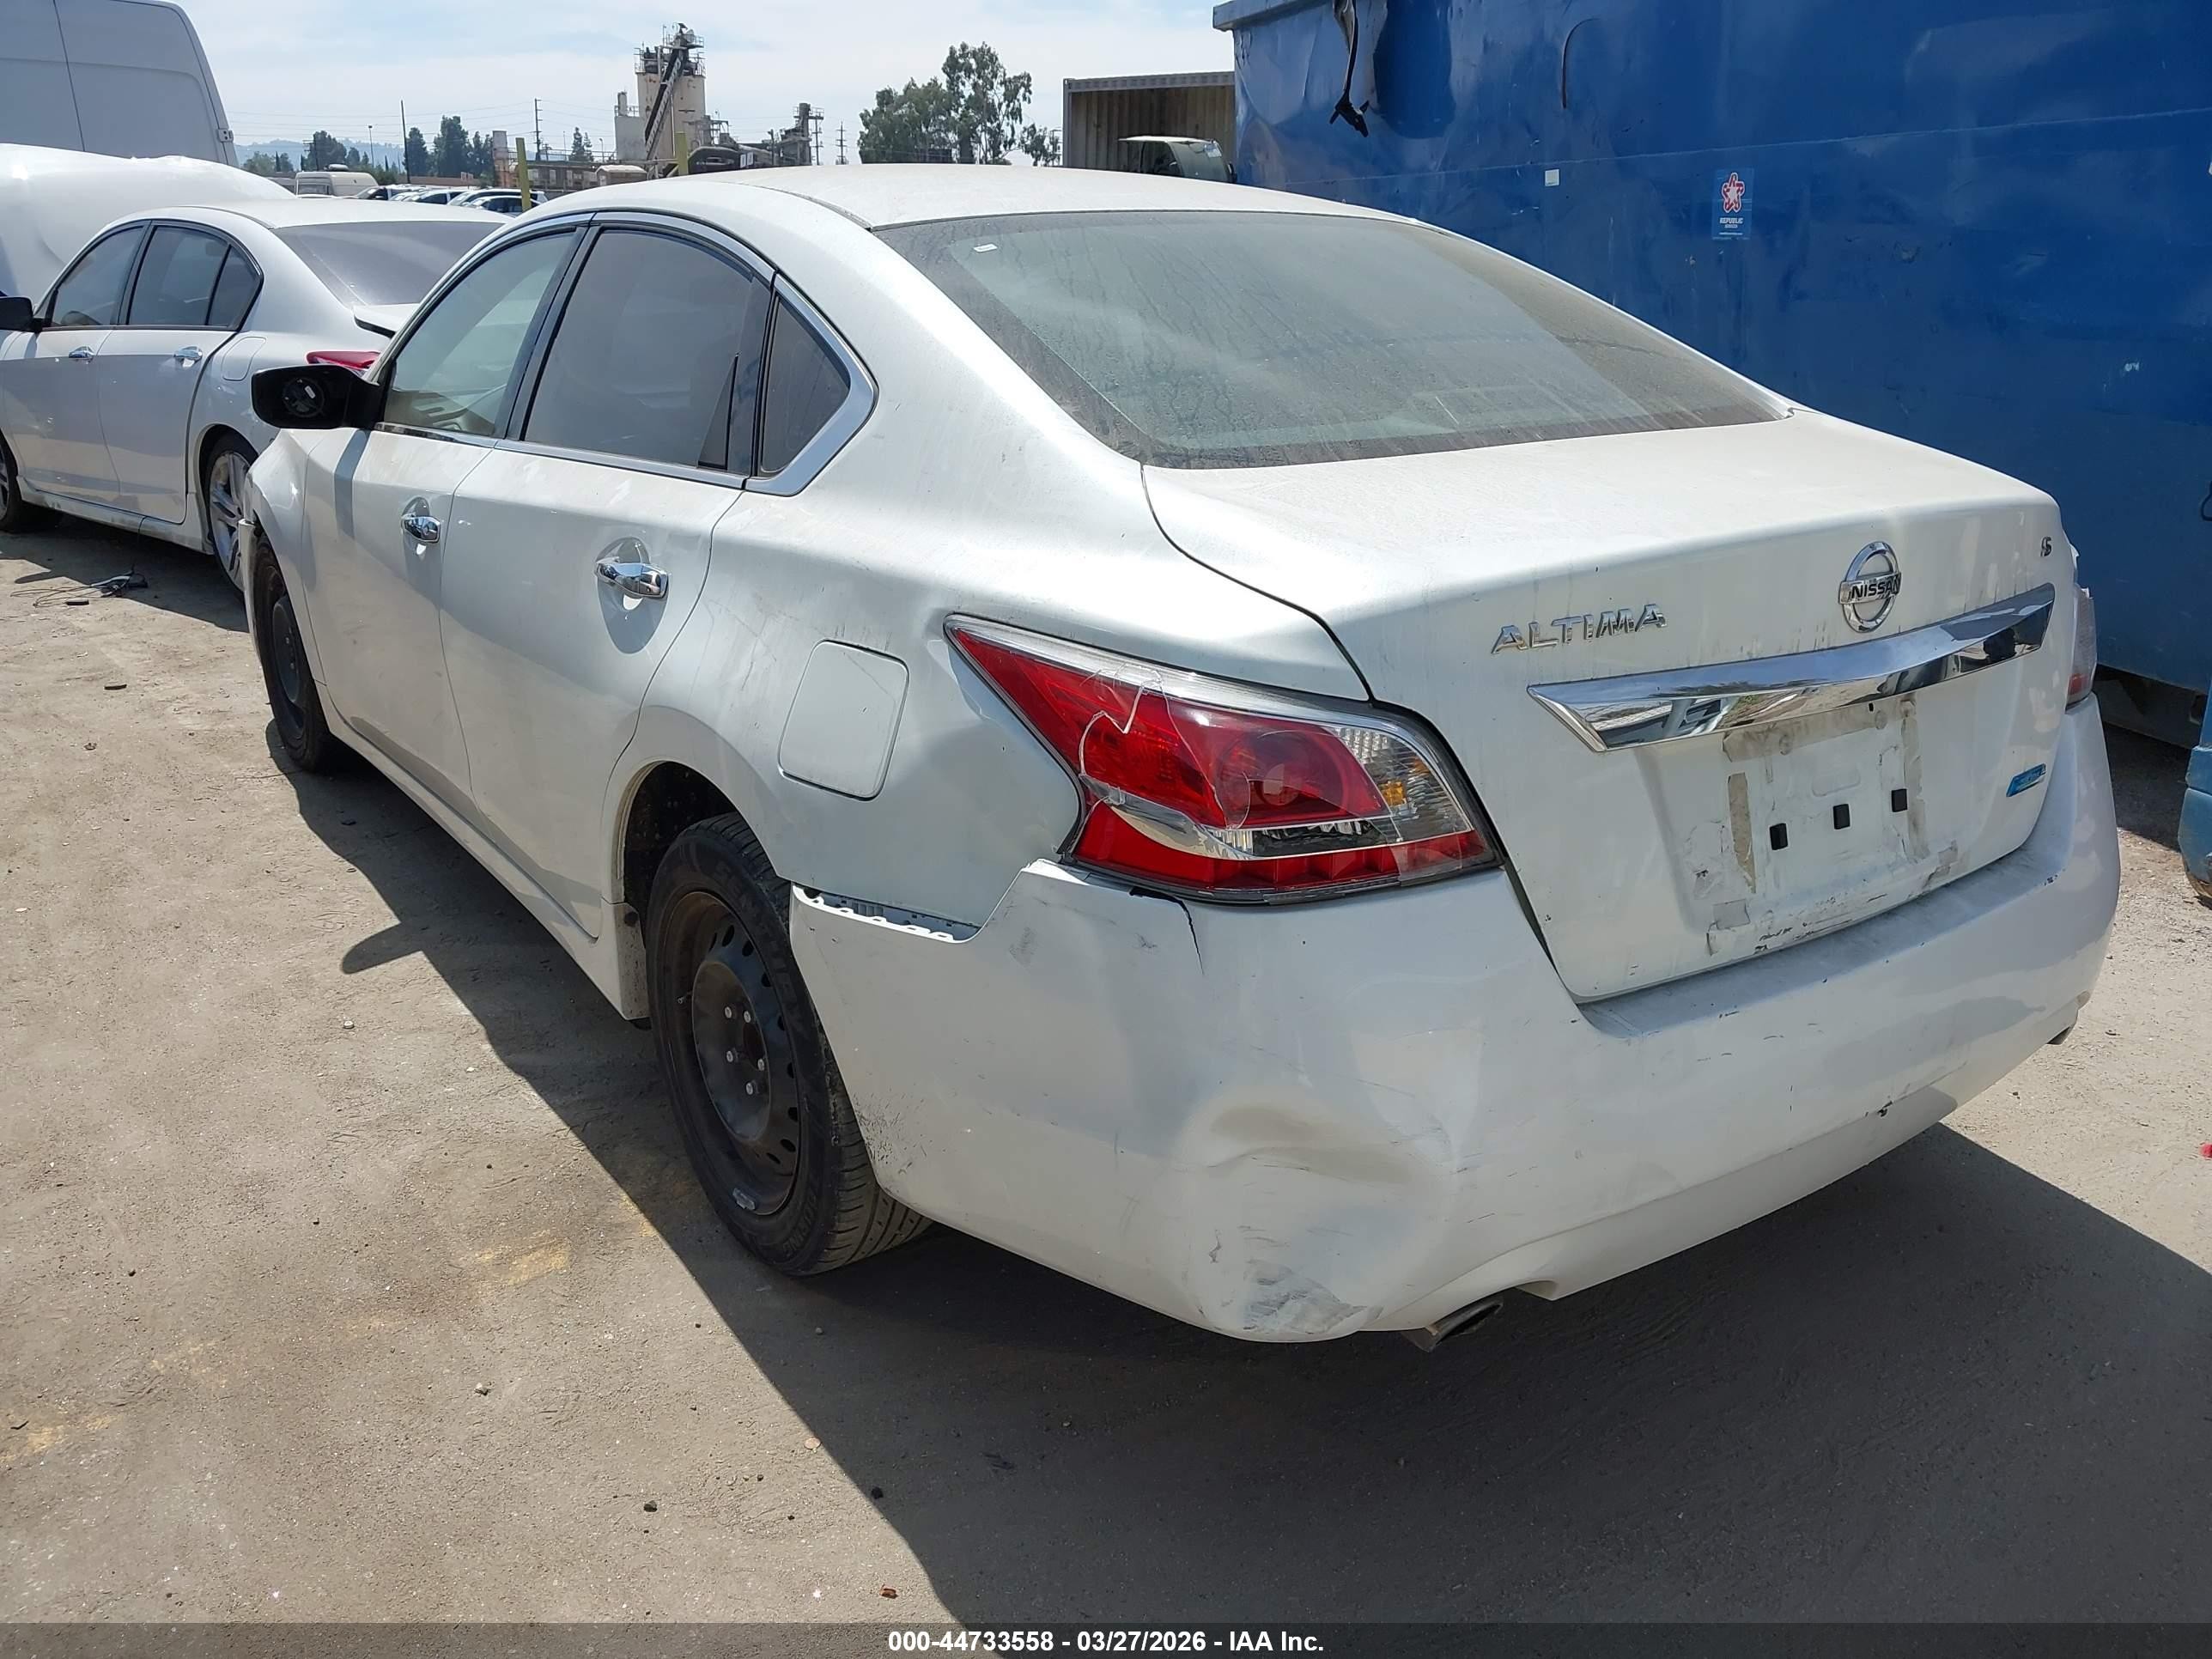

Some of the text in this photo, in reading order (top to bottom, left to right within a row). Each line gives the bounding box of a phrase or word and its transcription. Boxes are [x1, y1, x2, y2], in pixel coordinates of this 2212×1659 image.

[2040, 536, 2052, 557] S
[1850, 574, 1900, 599] NISSAN
[1491, 603, 1668, 654] ALTIMA
